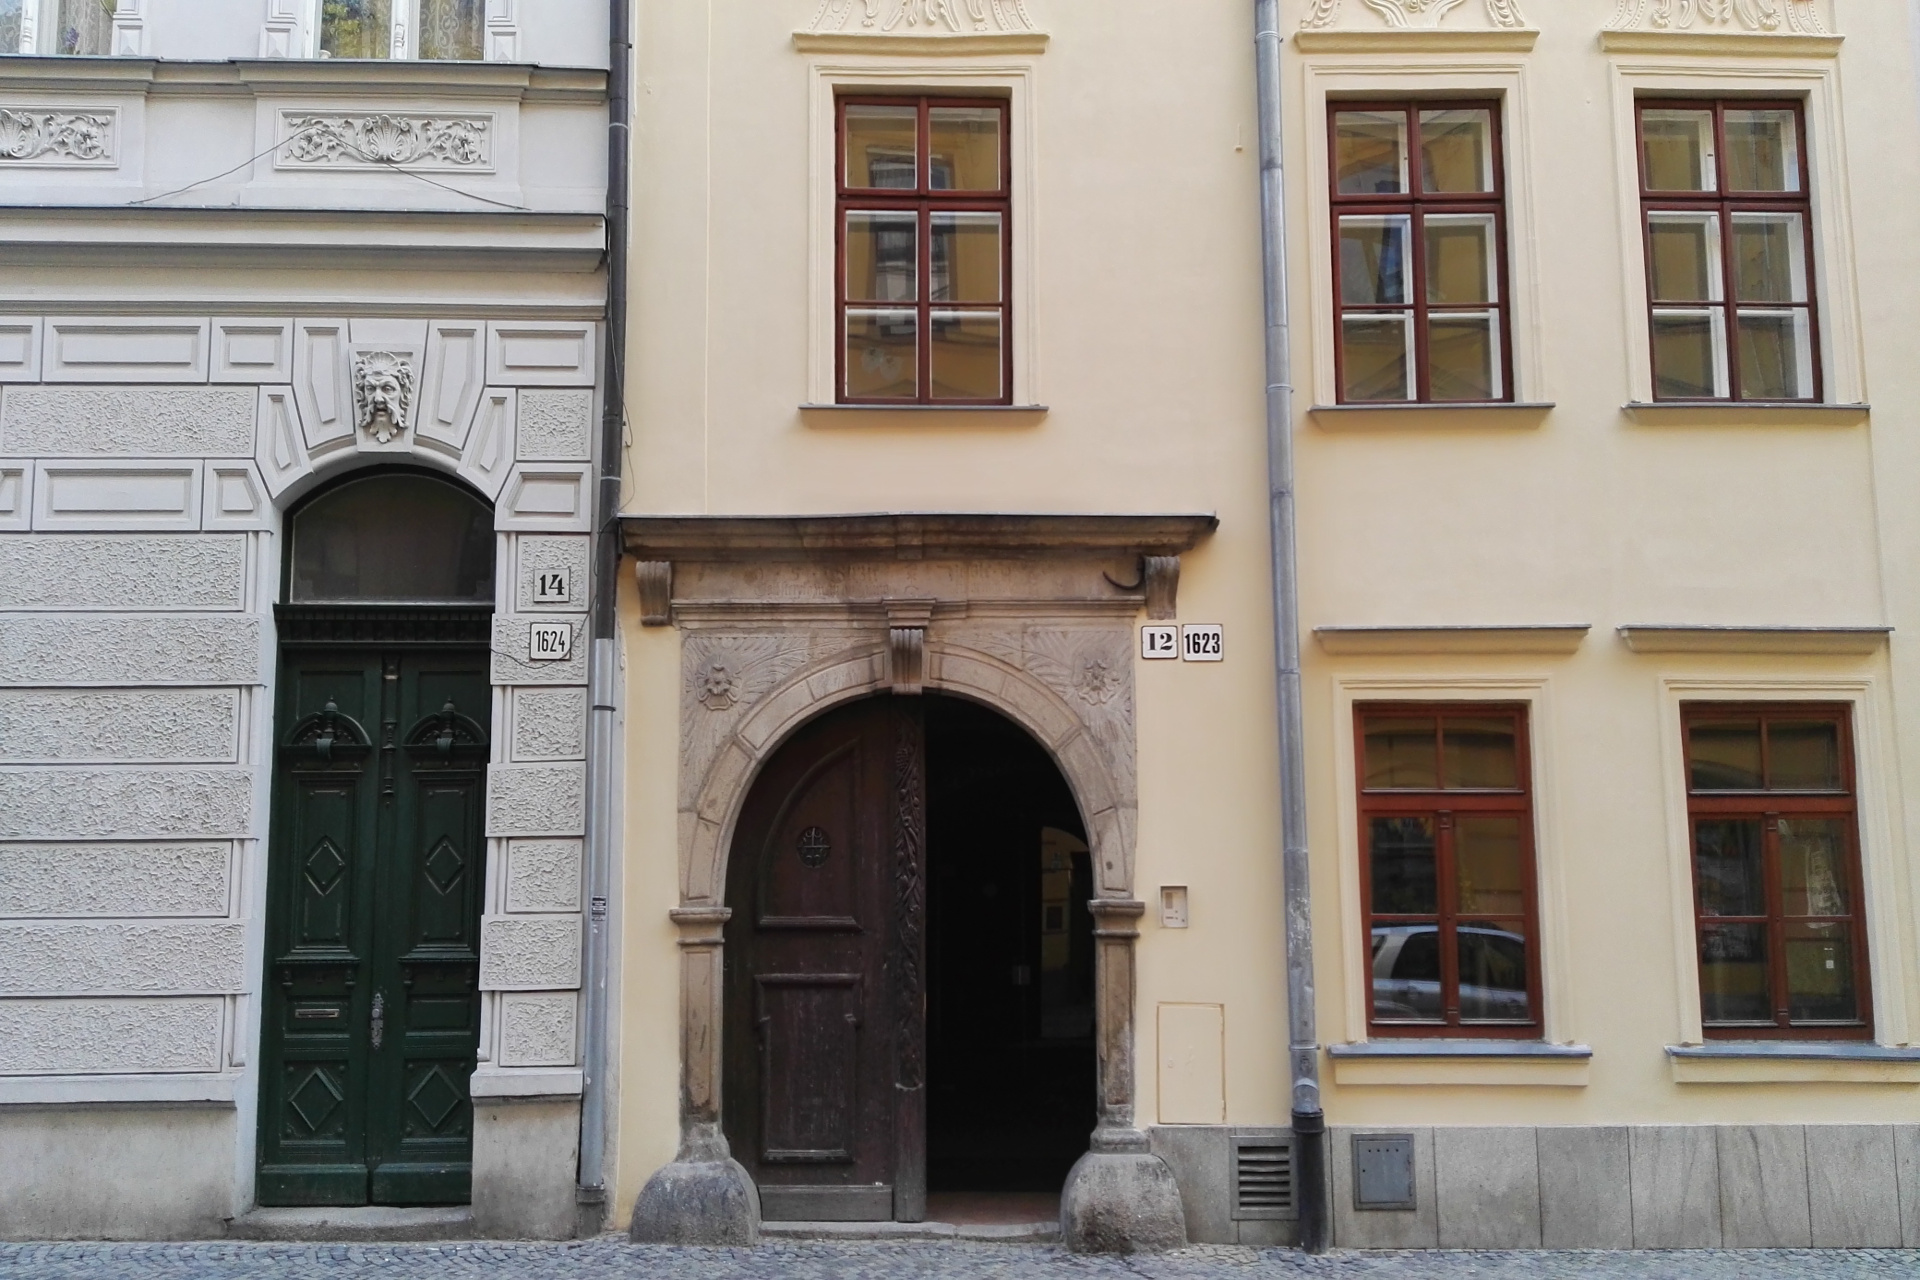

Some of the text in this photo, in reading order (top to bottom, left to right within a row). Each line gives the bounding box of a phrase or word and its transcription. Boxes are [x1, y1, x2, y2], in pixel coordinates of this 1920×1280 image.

[539, 574, 565, 596] 14
[535, 630, 565, 652] 1624
[1147, 632, 1173, 651] 12
[1184, 633, 1220, 654] 1623
